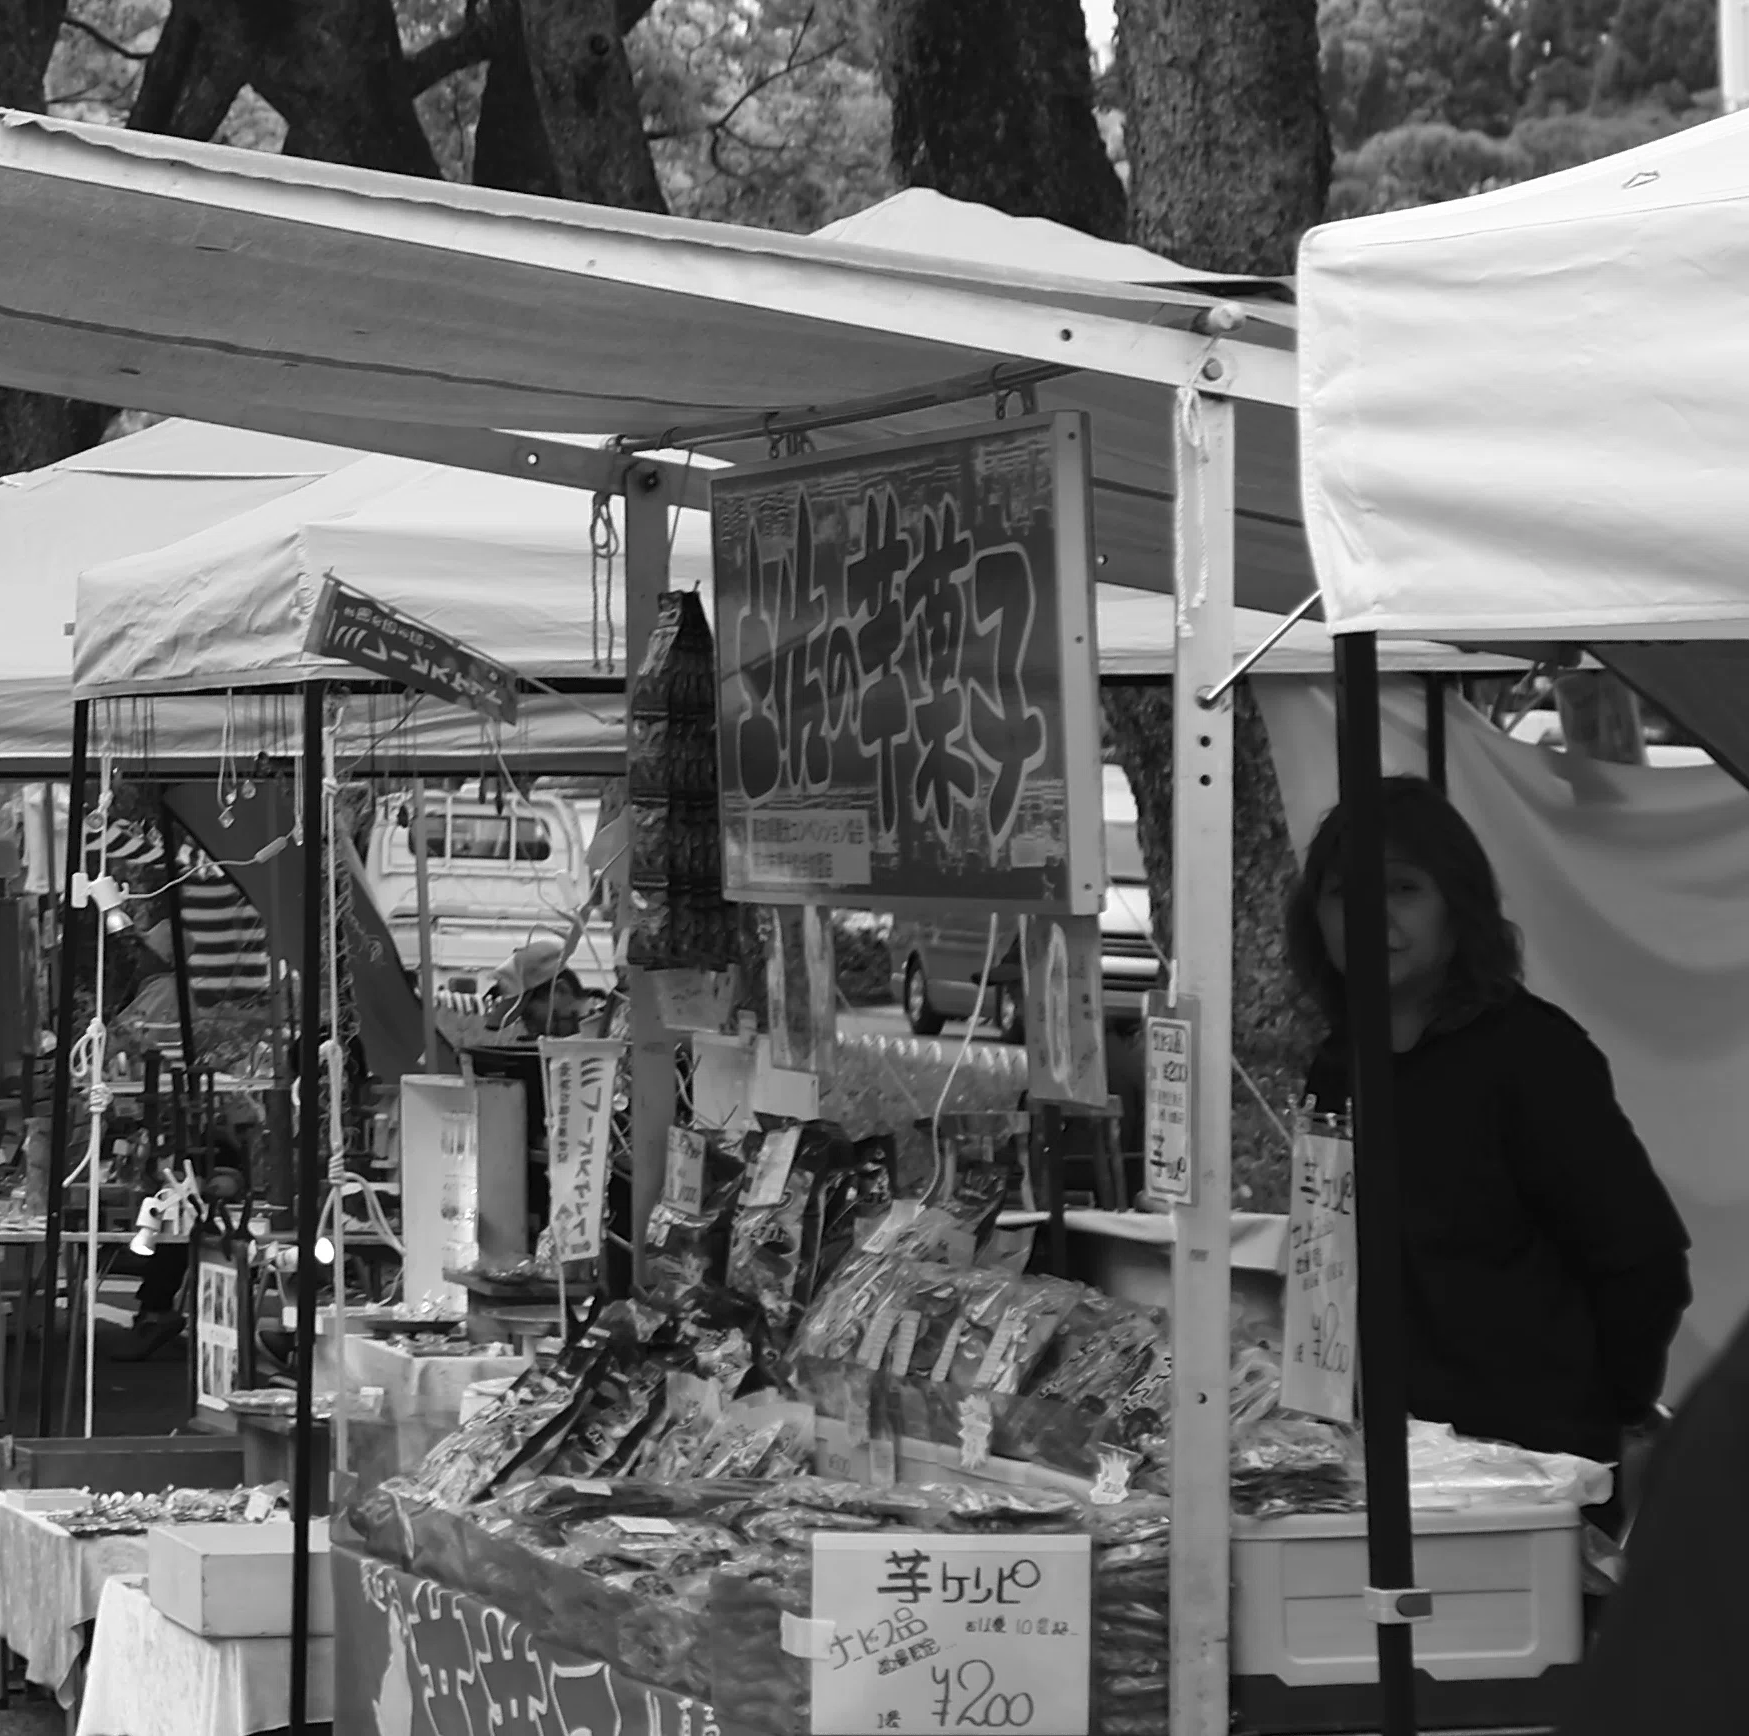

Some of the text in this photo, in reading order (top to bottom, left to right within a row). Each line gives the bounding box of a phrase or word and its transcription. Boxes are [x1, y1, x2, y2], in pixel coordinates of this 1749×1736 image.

[877, 1548, 1042, 1604] 芋ケンピ
[930, 1658, 1034, 1728] ¥200
